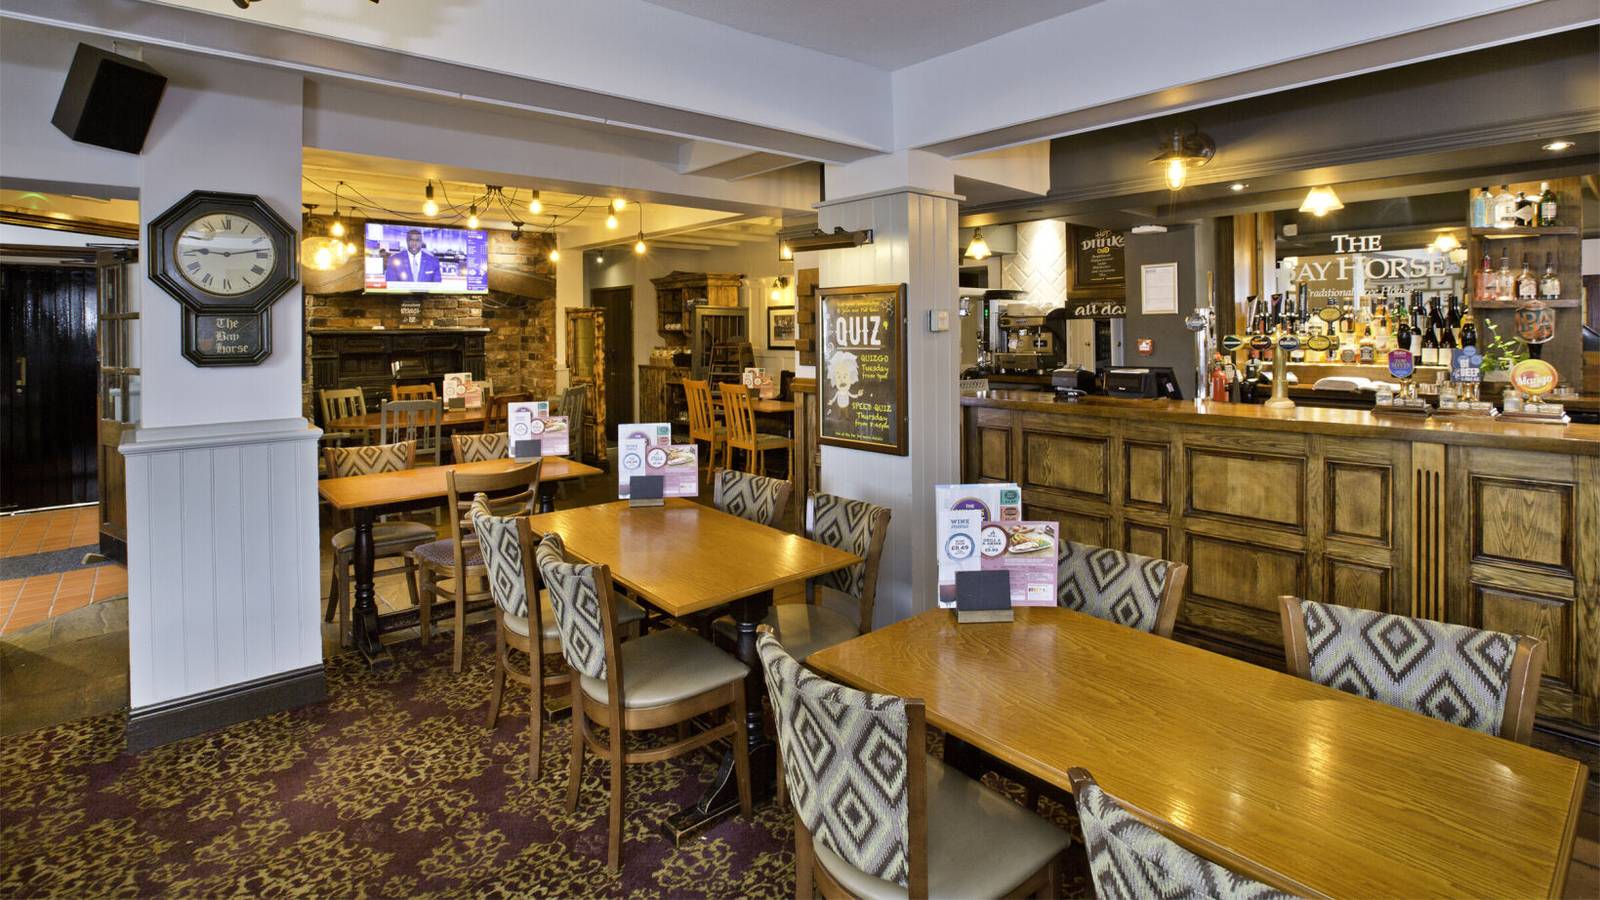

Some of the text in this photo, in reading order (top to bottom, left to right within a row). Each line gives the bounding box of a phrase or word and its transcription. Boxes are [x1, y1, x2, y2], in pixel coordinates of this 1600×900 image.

[1330, 234, 1382, 253] THE
[1336, 256, 1447, 281] HORSE
[216, 318, 239, 329] The
[836, 315, 881, 347] QUIZ
[216, 343, 249, 354] Horse
[861, 364, 889, 376] Tuesday
[852, 402, 892, 412] SPEED QUIZ
[856, 412, 888, 425] Thursday
